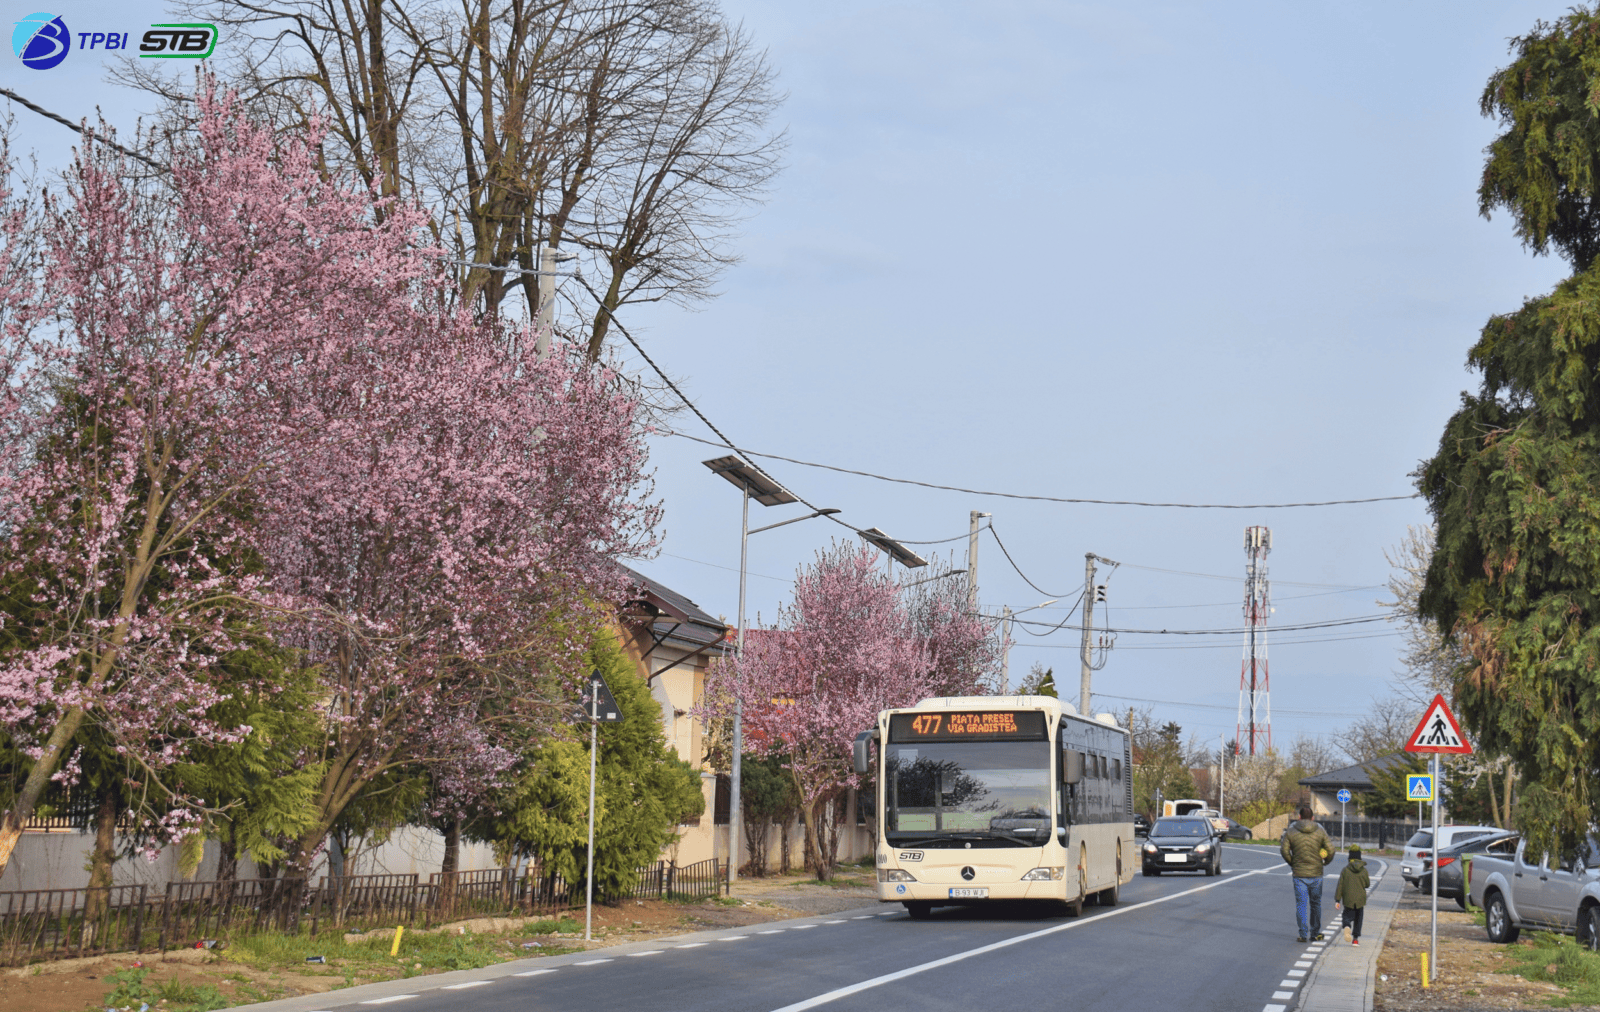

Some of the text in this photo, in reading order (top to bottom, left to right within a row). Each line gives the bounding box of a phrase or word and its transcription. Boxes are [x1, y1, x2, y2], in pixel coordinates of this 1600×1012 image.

[951, 713, 1014, 724] PIATA PRESEI
[912, 715, 942, 734] 477
[947, 722, 1018, 733] VIA GRADISTEA
[899, 852, 922, 860] STB
